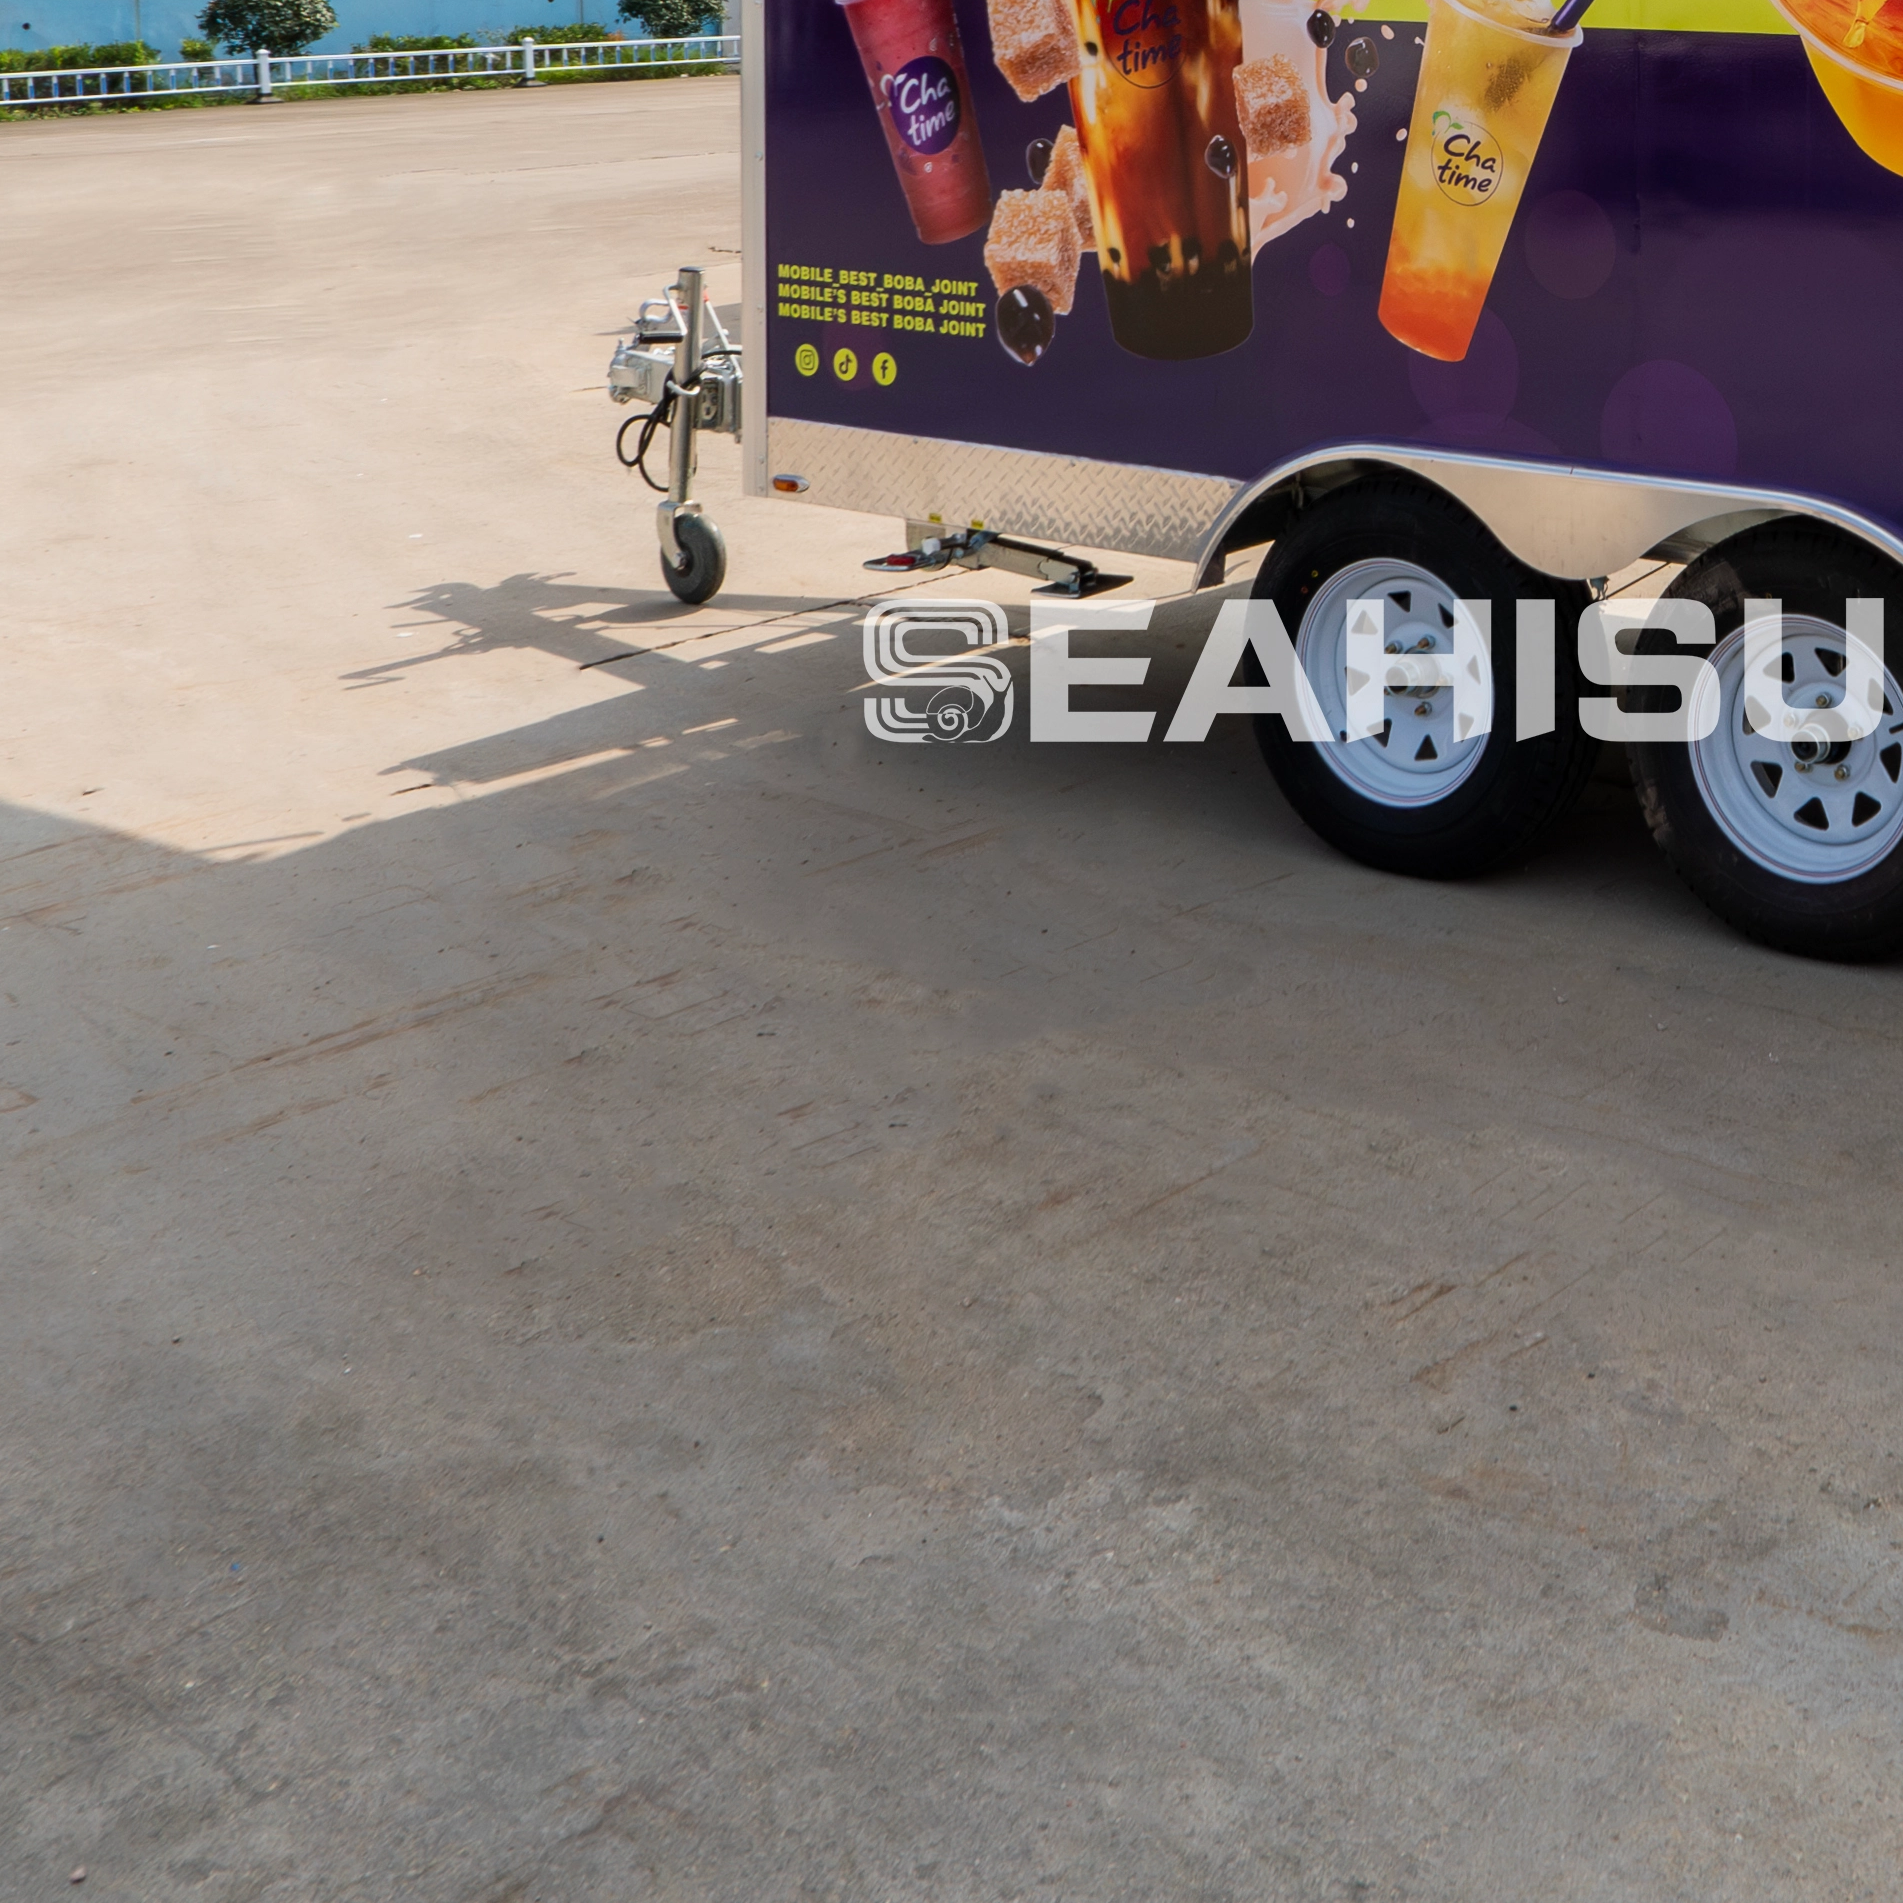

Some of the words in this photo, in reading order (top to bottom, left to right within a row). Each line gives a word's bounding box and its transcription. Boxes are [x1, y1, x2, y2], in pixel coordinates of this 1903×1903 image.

[1117, 34, 1182, 75] time
[900, 73, 951, 114] Cha
[907, 101, 955, 146] time
[1444, 134, 1496, 173] Cha
[1437, 158, 1492, 192] time
[778, 283, 846, 304] MOBILE'S
[851, 290, 889, 308] BEST
[893, 294, 935, 313] BOBA
[939, 300, 986, 318] JOINT
[778, 303, 846, 323] MOBILE'S
[851, 310, 889, 328] BEST
[893, 314, 935, 333] BOBA
[939, 319, 986, 338] JOINT
